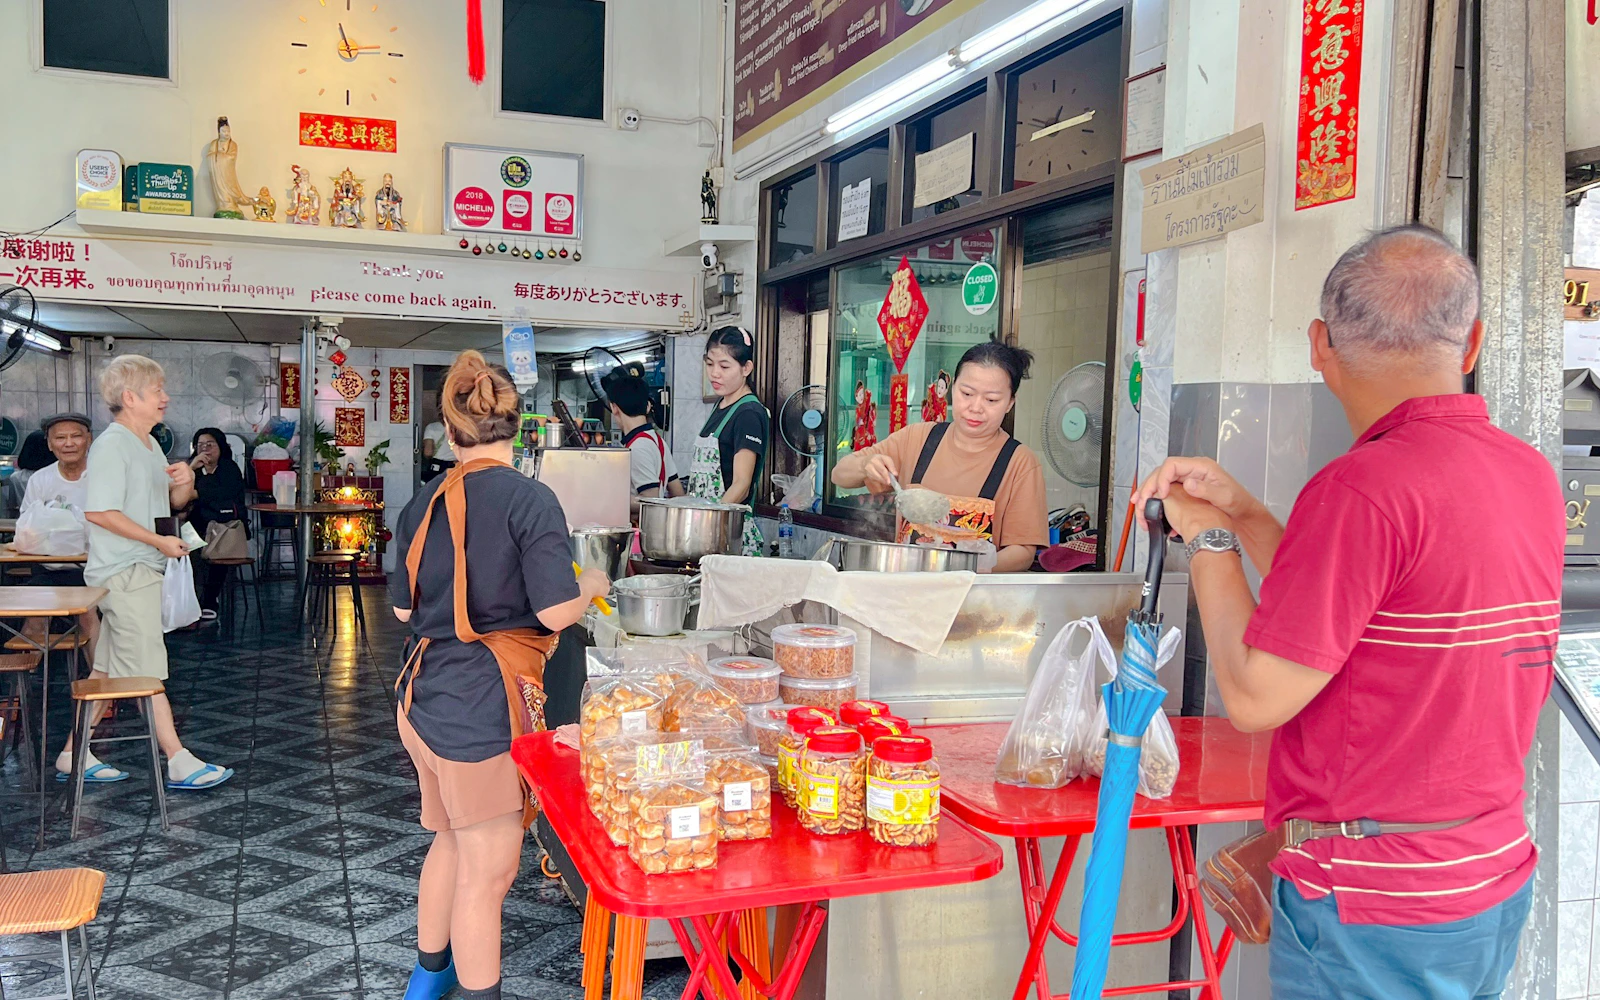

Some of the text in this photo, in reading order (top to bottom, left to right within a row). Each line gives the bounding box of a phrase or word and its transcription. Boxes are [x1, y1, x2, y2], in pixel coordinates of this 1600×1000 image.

[307, 120, 390, 145] 生意興隆
[465, 191, 484, 200] 2018
[455, 203, 493, 213] MICHELIN
[0, 238, 90, 262] 感谢啦！
[170, 251, 234, 271] โจ๊กปรินซ์
[360, 261, 444, 282] Thank you
[106, 274, 295, 300] ขอขอบคุณทุกท่านที่มาอุดหนุน
[967, 275, 993, 285] CLOSED
[310, 287, 497, 311] please come back again.
